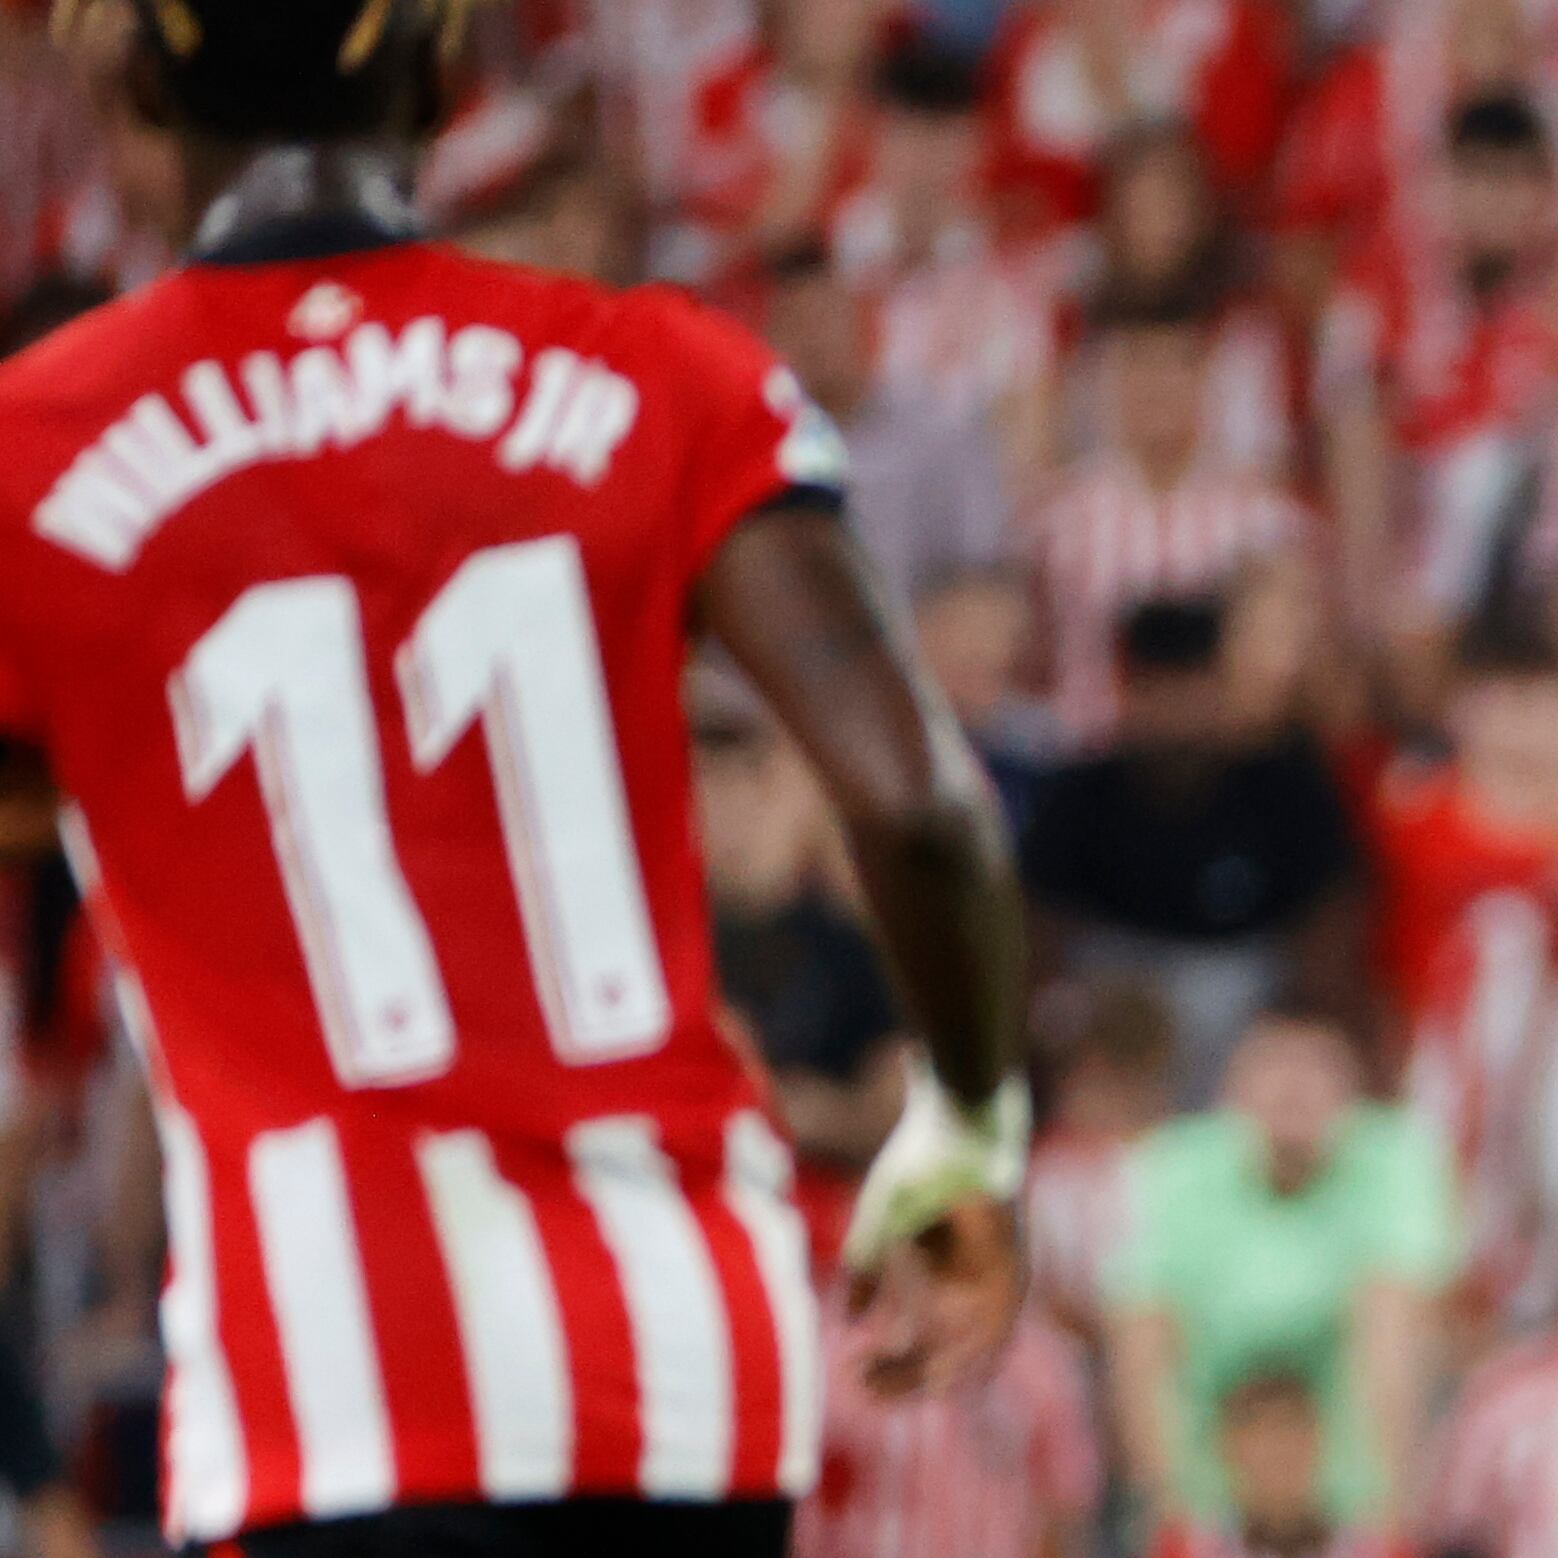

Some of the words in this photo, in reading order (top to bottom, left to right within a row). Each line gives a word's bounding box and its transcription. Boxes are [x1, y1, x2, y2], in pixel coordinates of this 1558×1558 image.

[32, 315, 524, 573] WILLIAMS
[495, 345, 640, 489] JR
[165, 532, 673, 1091] 11
